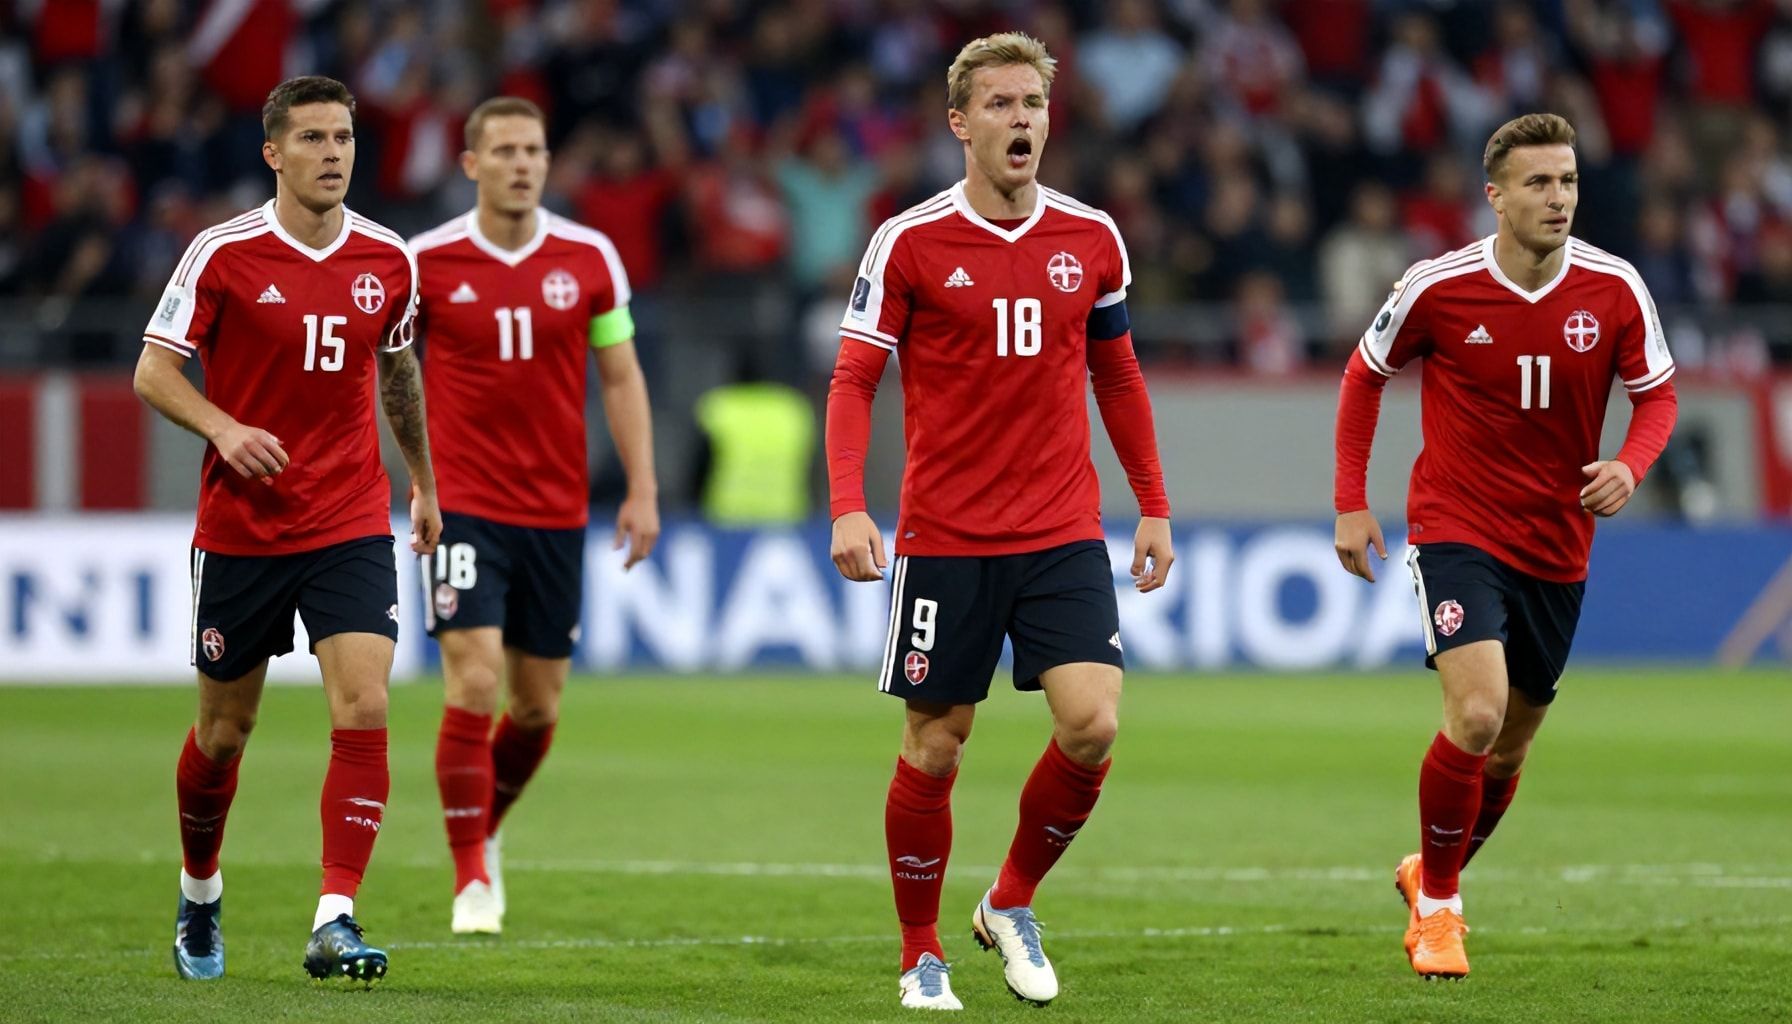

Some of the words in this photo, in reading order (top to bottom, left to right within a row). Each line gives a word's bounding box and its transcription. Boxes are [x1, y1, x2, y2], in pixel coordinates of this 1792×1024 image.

[303, 314, 348, 372] 15
[494, 306, 534, 361] 11
[992, 297, 1042, 357] 18
[1516, 355, 1551, 409] 11
[911, 597, 938, 652] 9
